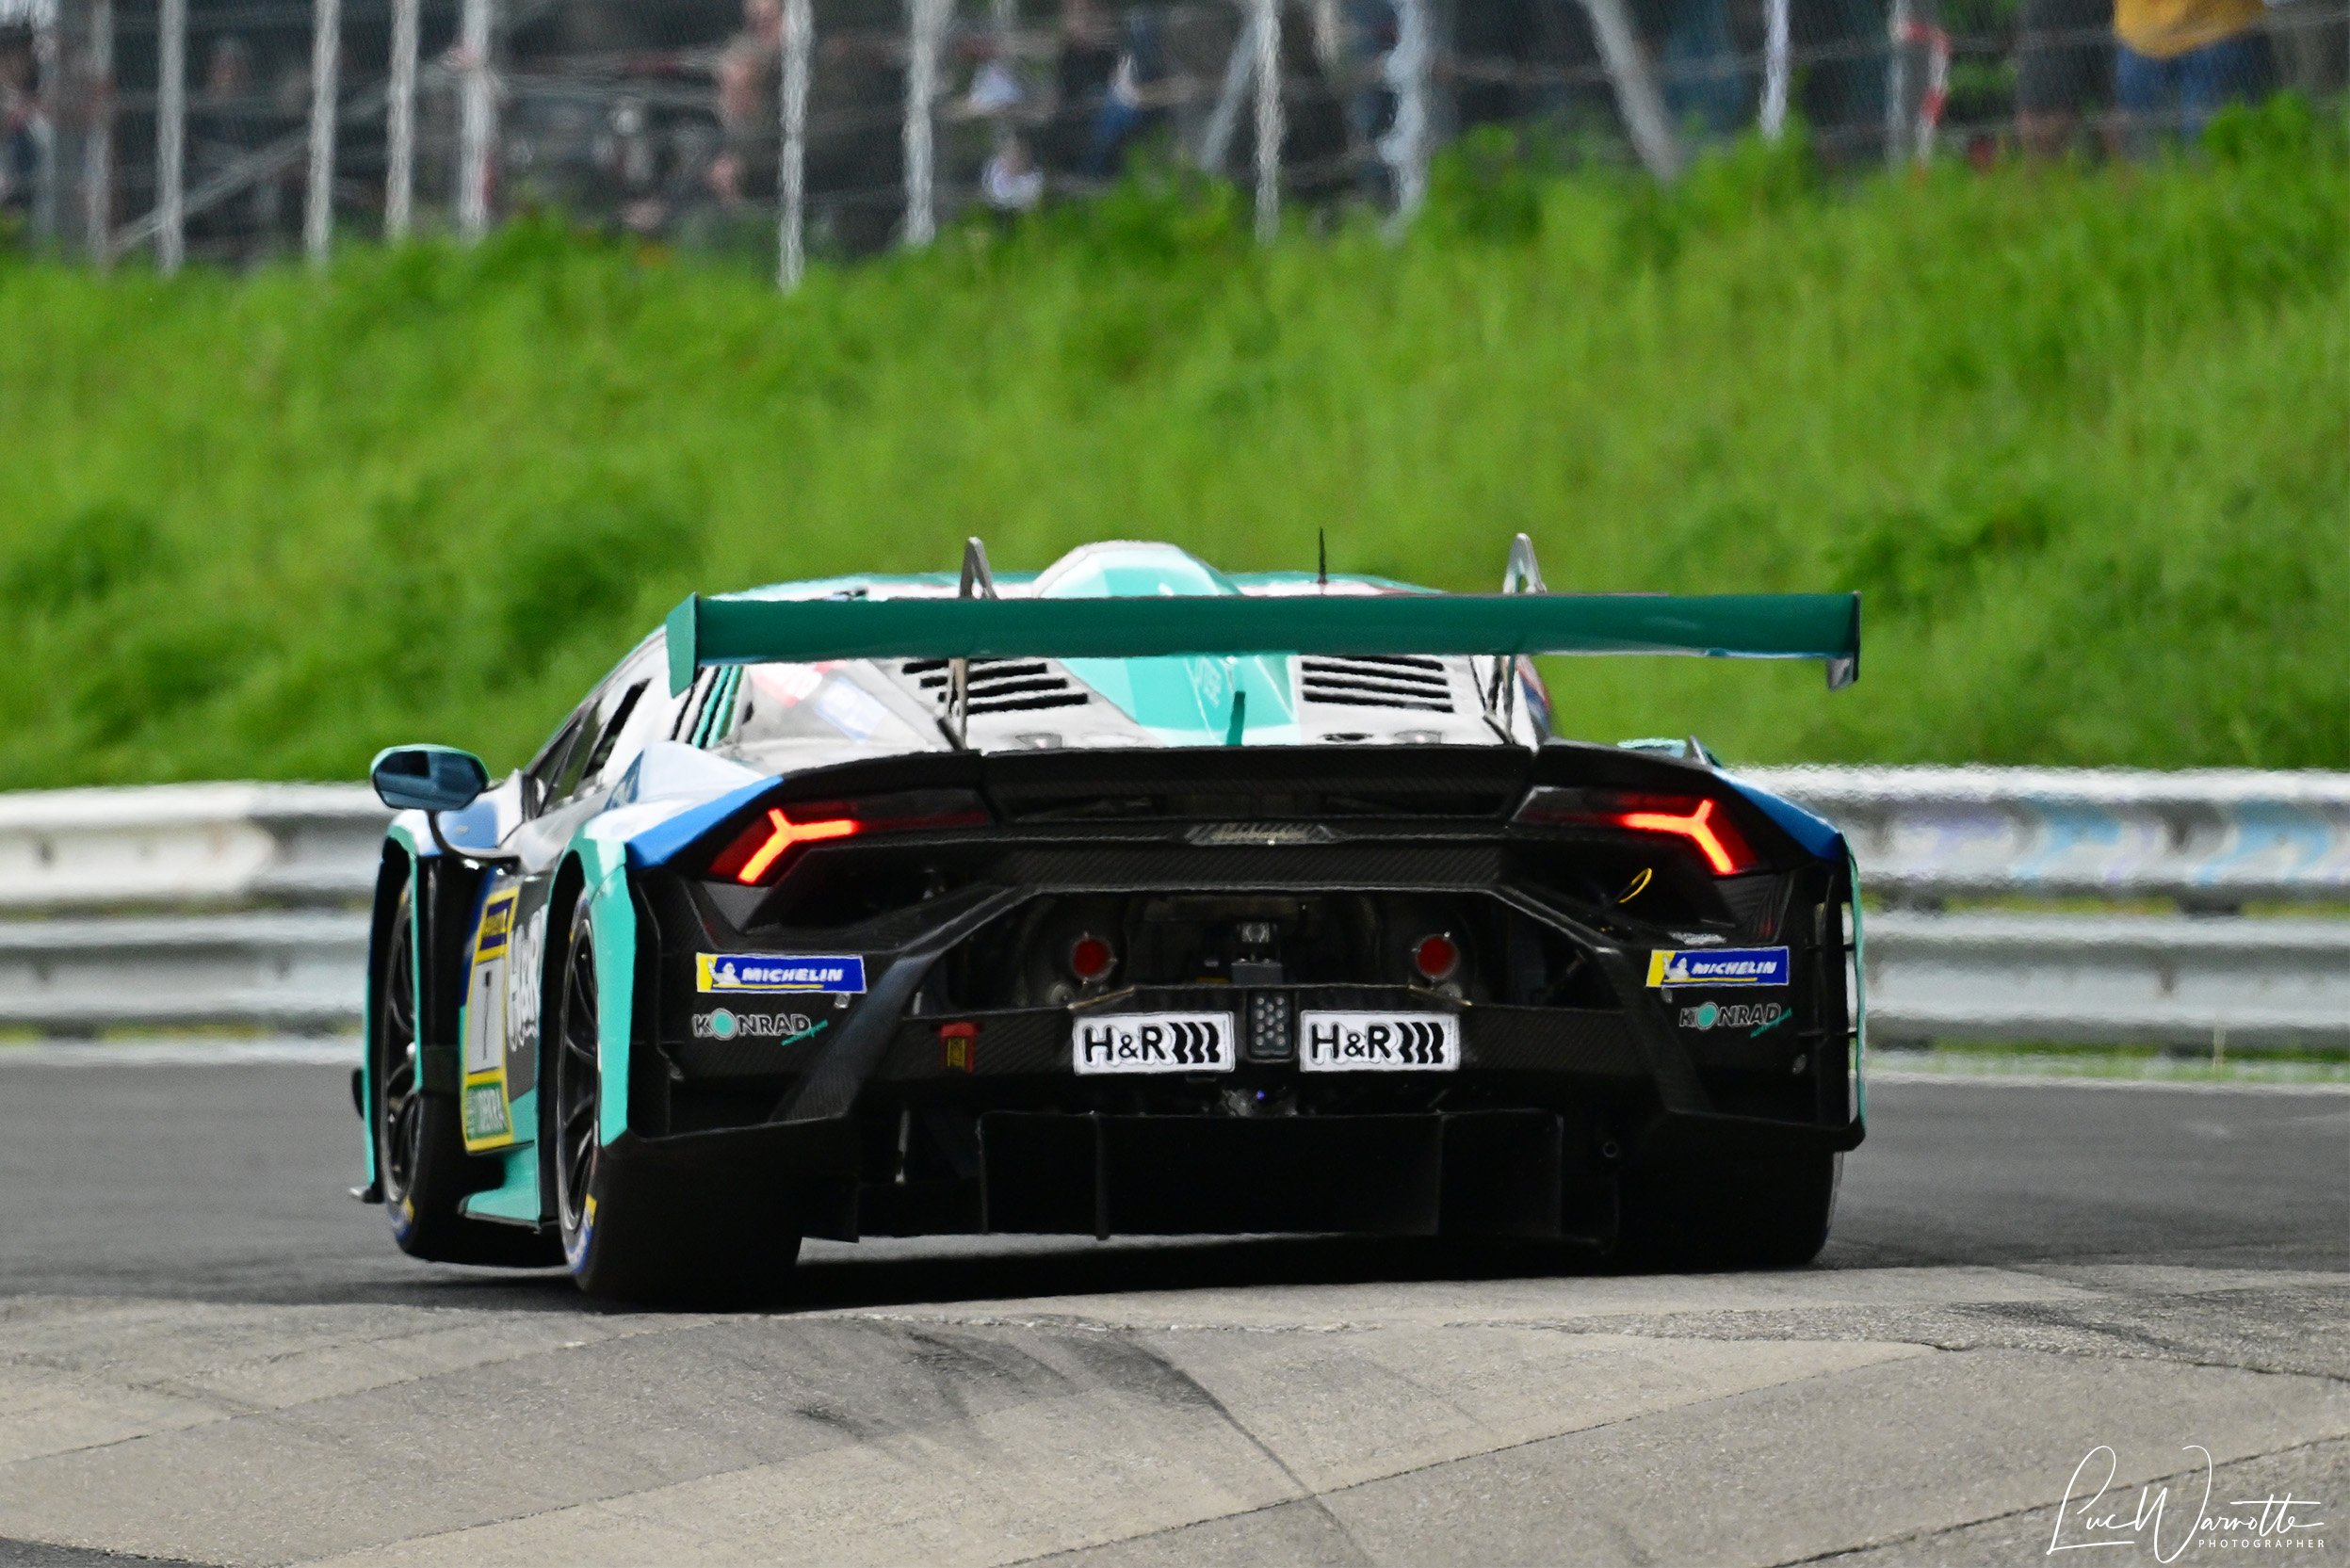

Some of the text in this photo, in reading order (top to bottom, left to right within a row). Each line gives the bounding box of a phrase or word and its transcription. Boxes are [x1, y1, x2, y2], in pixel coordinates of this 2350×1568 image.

[742, 967, 844, 982] MICHELIN
[1691, 961, 1777, 975] MICHELIN
[691, 1008, 812, 1040] KONRAD
[1678, 1002, 1782, 1031] KONRAD
[1083, 1025, 1164, 1061] H&R
[1310, 1023, 1391, 1059] H&R
